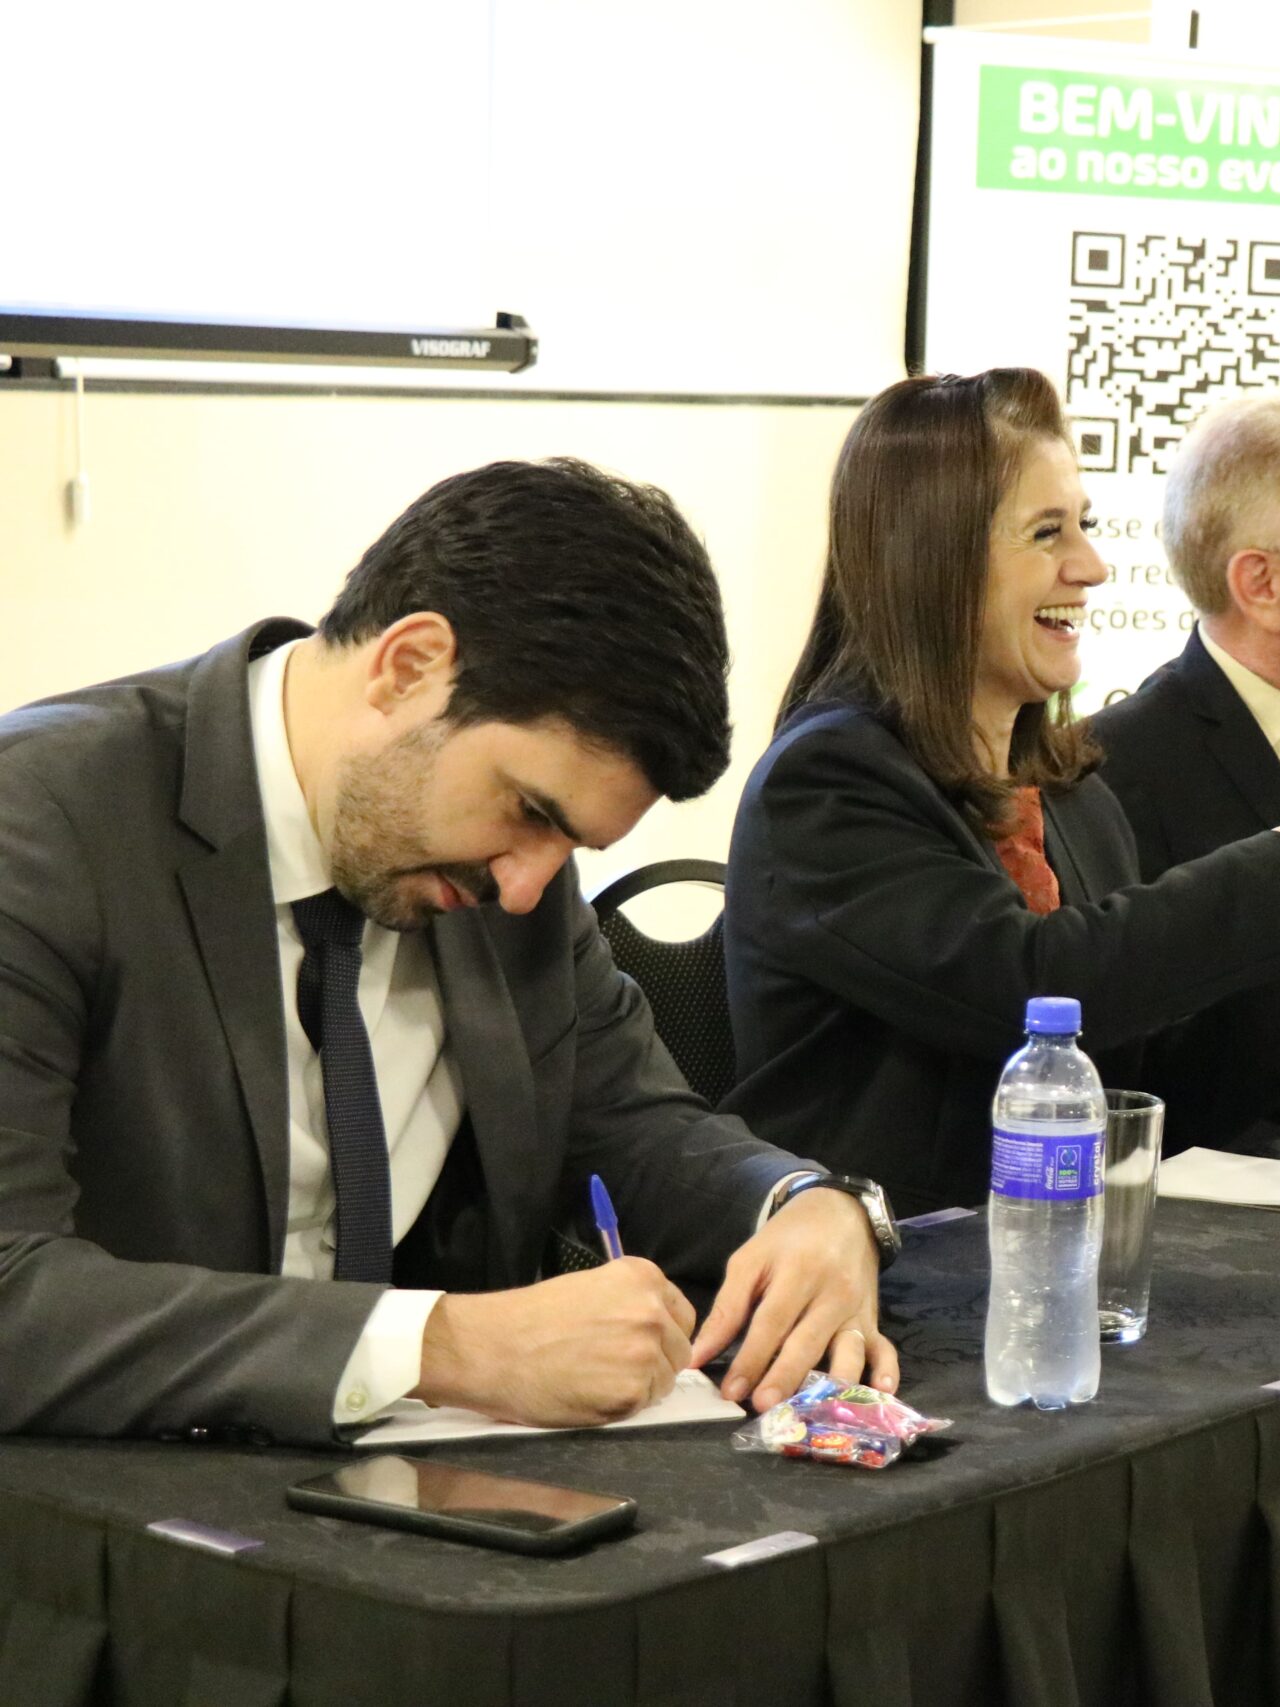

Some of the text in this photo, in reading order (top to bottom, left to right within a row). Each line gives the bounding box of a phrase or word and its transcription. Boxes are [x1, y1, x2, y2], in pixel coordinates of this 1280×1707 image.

[1009, 144, 1067, 181] ao
[1076, 147, 1209, 190] nosso
[410, 338, 491, 358] VISOGRAF
[1090, 600, 1167, 635] ções
